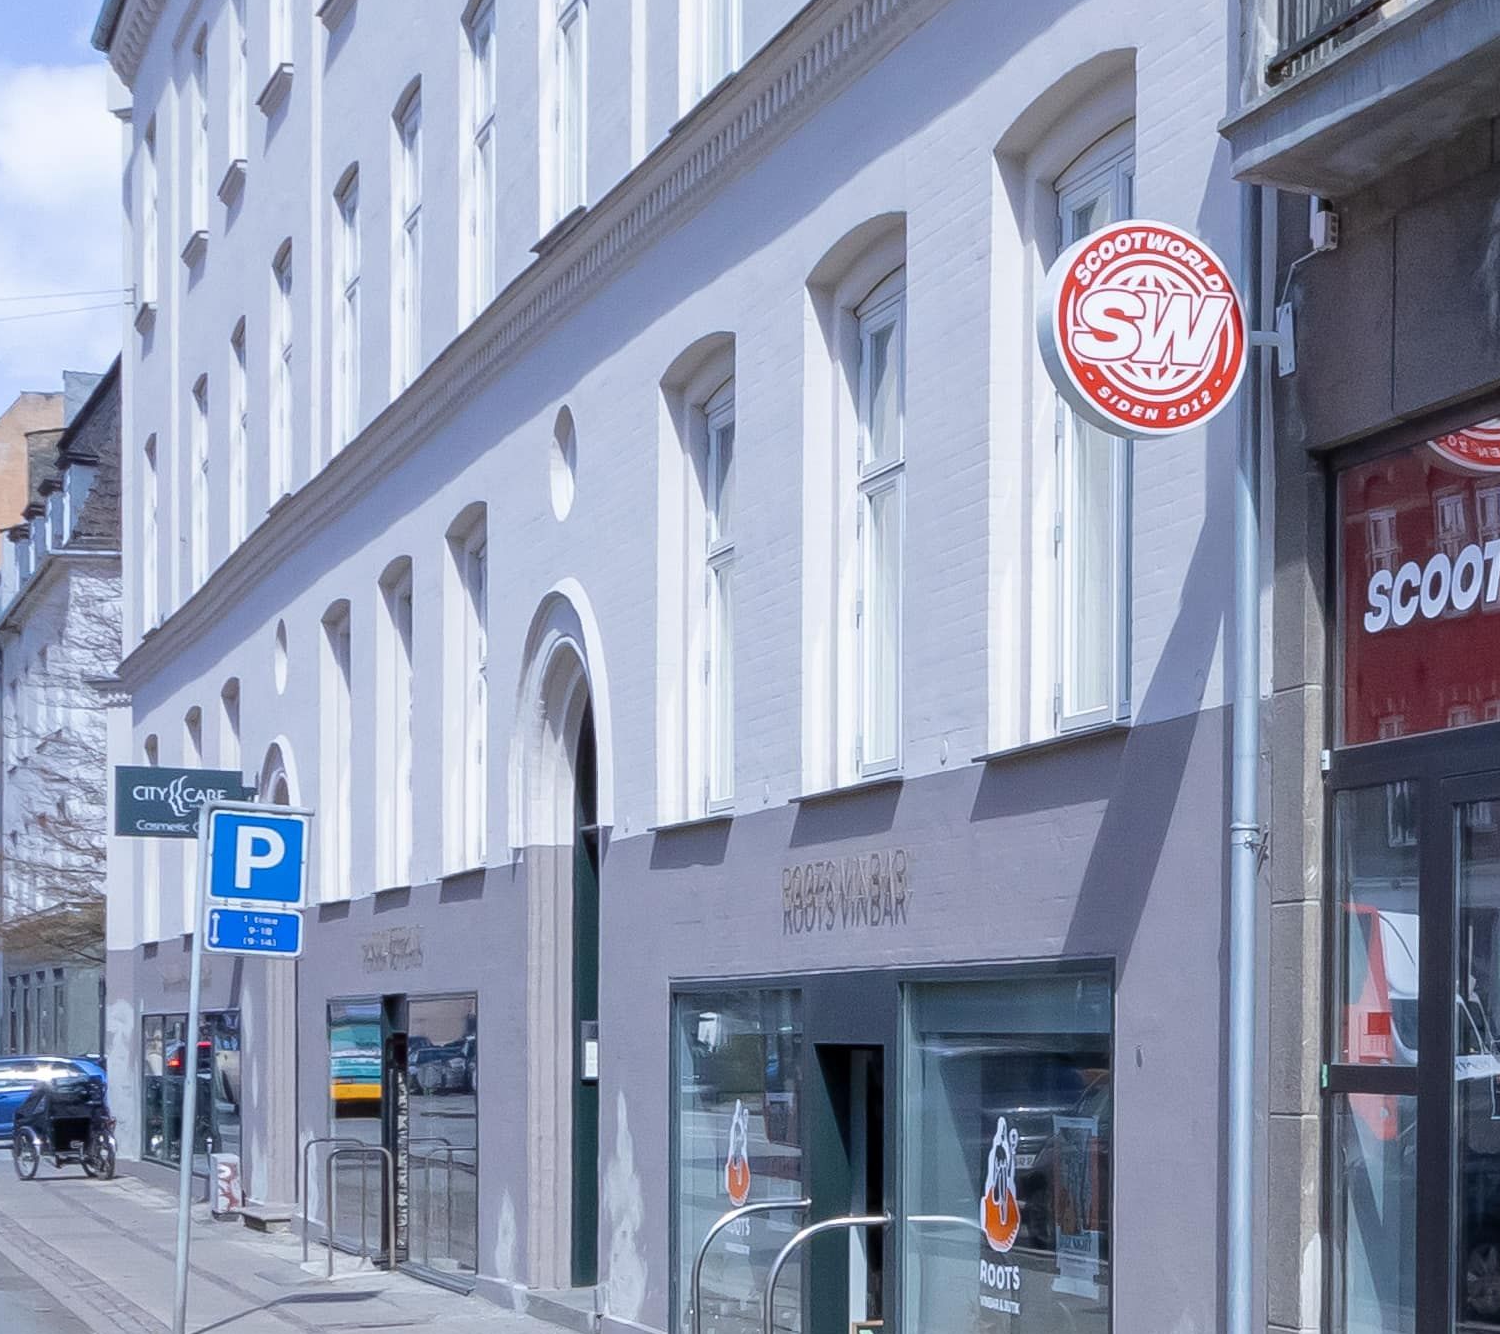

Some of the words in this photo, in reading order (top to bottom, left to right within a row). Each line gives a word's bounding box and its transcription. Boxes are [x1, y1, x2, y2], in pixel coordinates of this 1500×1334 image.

[1074, 232, 1224, 291] SCOOTWORLD
[1071, 287, 1232, 367] SW
[1097, 386, 1159, 420] SIDEN
[1166, 390, 1212, 420] 2012
[132, 785, 169, 801] CITY
[182, 787, 228, 803] CARE
[234, 825, 286, 889] P
[782, 860, 837, 925] ROOTS
[980, 1259, 1021, 1290] ROOTS
